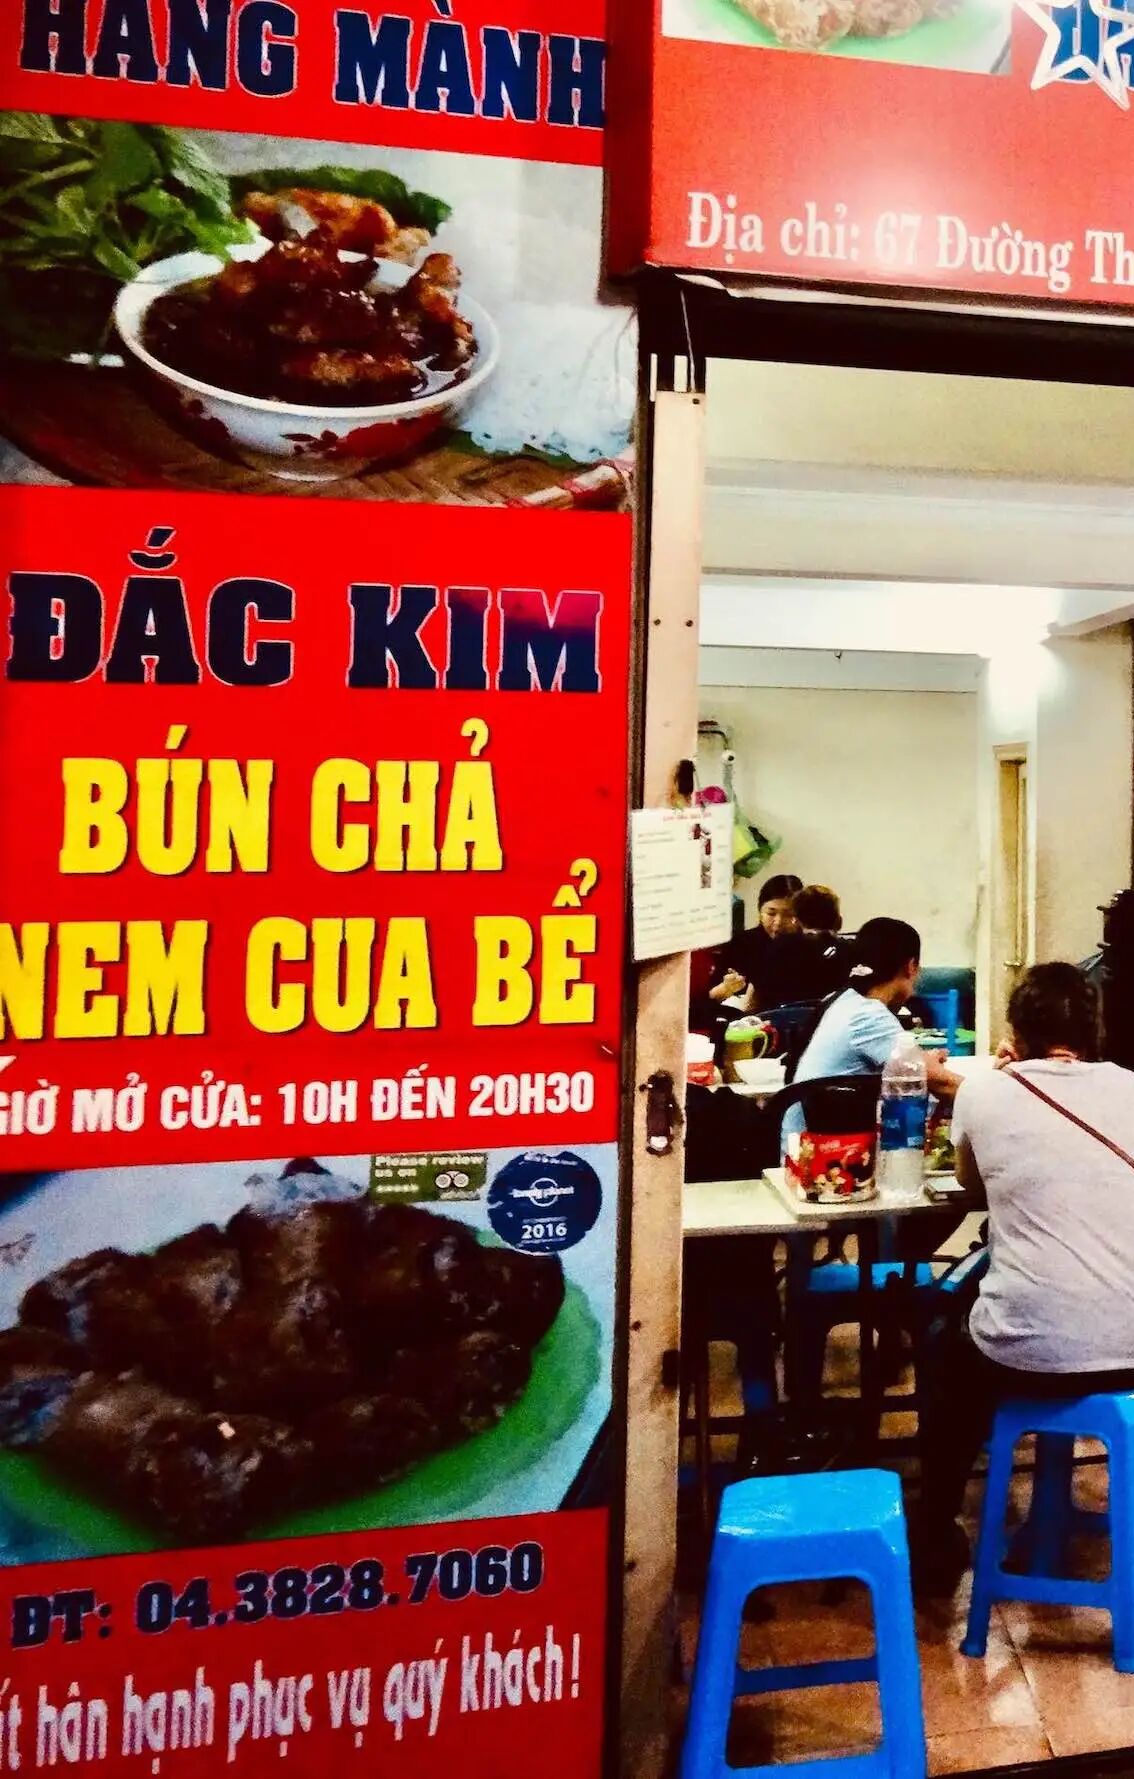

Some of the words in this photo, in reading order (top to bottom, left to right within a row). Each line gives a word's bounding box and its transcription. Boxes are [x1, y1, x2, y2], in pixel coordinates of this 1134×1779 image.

[333, 0, 606, 129] MÀNH
[685, 192, 765, 265] Địa
[780, 201, 860, 261] chỉ:
[875, 211, 922, 266] 67
[936, 215, 1073, 293] Đường
[5, 526, 296, 687] ĐẮC
[346, 582, 604, 693] KIM
[59, 724, 275, 875] BÚN
[310, 717, 504, 873] CHẢ
[0, 919, 209, 1041] NEM
[246, 915, 438, 1033] CUA
[472, 858, 598, 1027] BỂ
[71, 1072, 148, 1133] MỞ
[160, 1070, 262, 1130] CỬA:
[278, 1081, 357, 1125] 10H
[371, 1064, 457, 1120] ĐẾN
[469, 1071, 595, 1116] 20H30
[521, 1223, 568, 1240] 2016
[12, 1588, 112, 1650] ĐT:
[135, 1541, 545, 1635] 04.3828.7060
[36, 1681, 108, 1767] hân
[121, 1665, 214, 1775] hạnh
[227, 1659, 313, 1763] phục
[328, 1663, 371, 1748] vụ
[383, 1637, 447, 1741] quý
[459, 1624, 582, 1714] khách!
